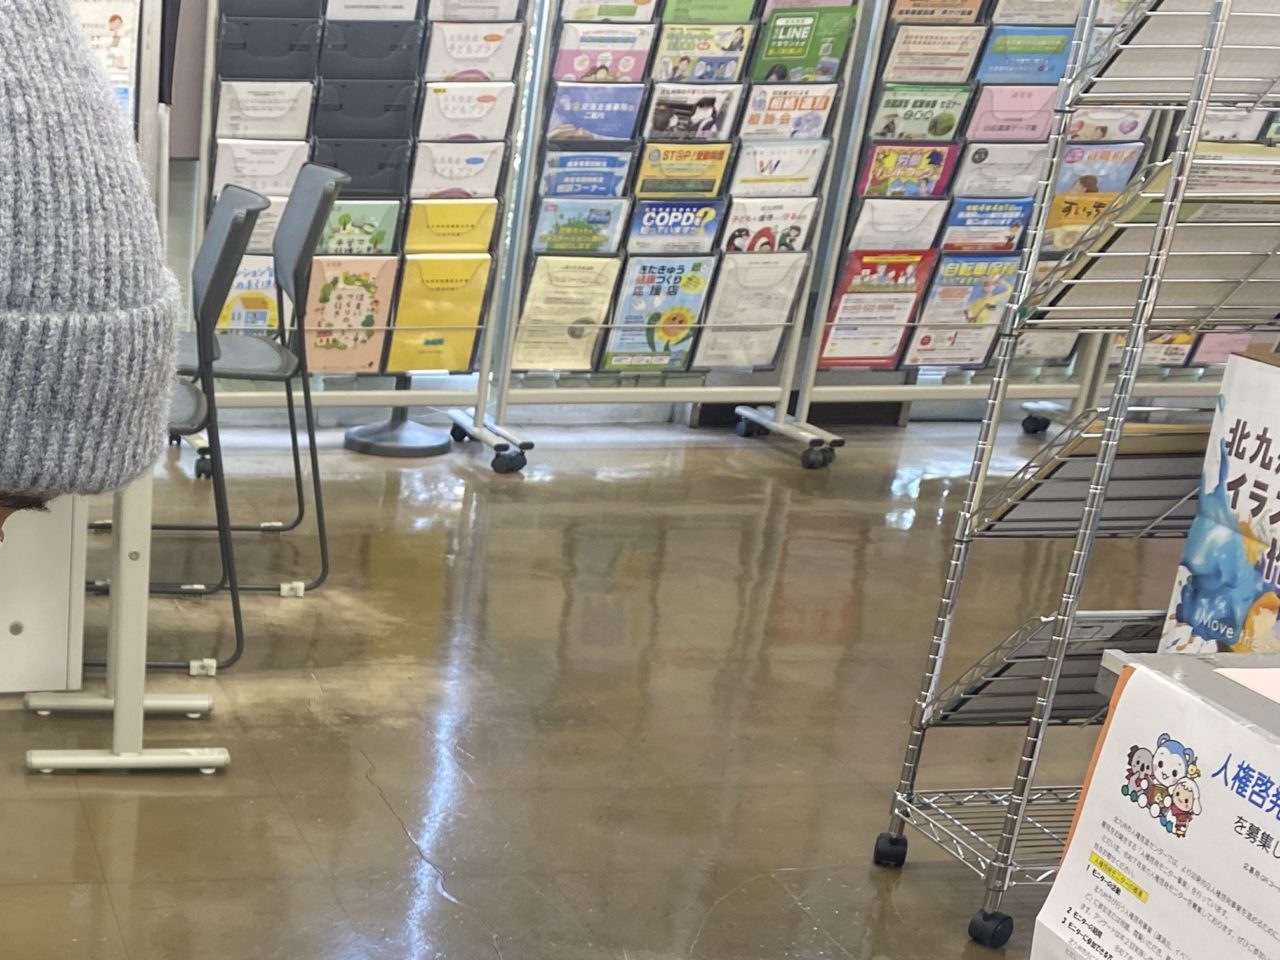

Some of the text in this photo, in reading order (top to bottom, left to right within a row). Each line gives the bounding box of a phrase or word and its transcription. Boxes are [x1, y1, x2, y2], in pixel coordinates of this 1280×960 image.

[778, 26, 810, 39] LINE
[639, 265, 685, 275] きたきゅう
[1225, 418, 1280, 474] 北九
[1200, 611, 1234, 639] Move
